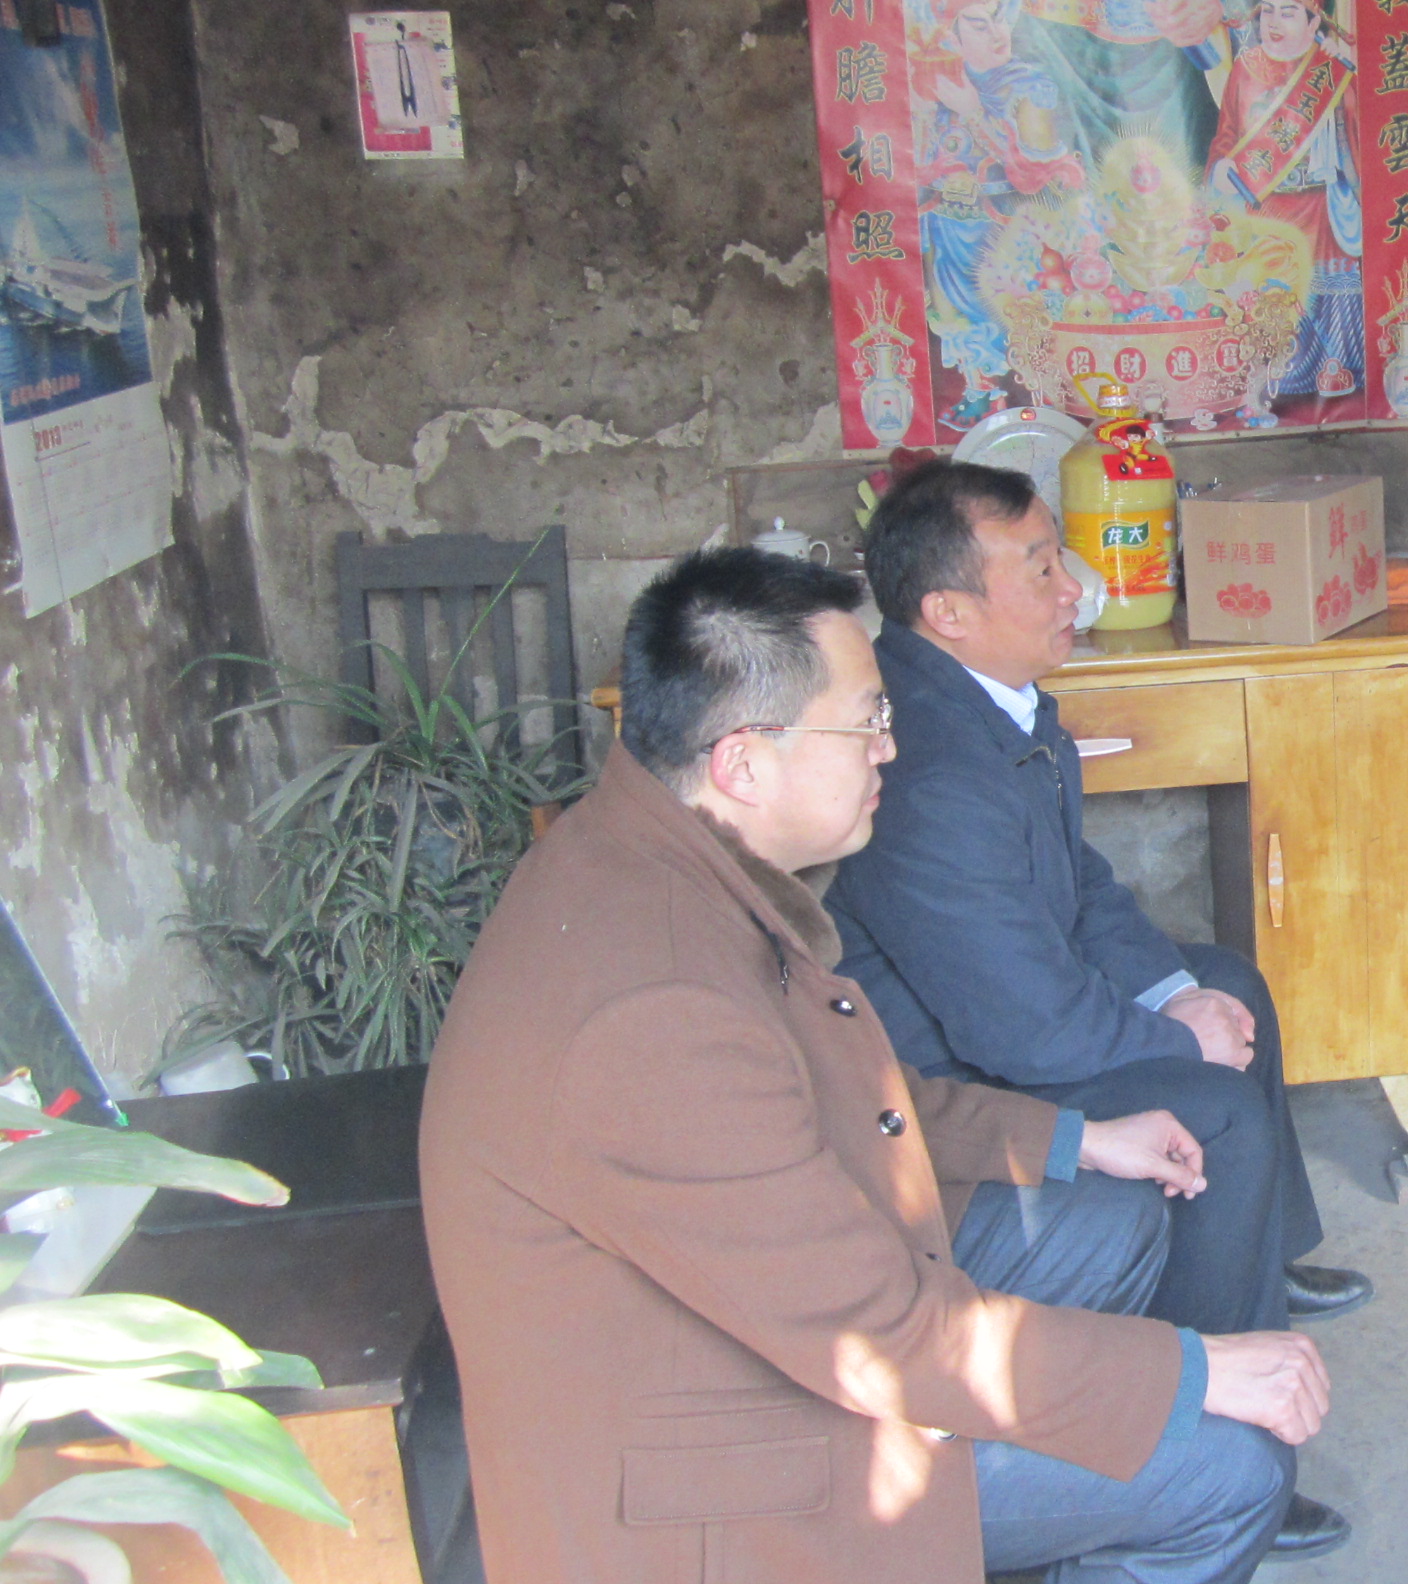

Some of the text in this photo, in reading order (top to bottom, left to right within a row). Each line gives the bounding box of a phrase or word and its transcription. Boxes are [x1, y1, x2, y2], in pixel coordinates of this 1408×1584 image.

[34, 425, 63, 452] 2013
[1107, 526, 1144, 544] 龙大
[1206, 541, 1277, 566] 鲜鸡蛋
